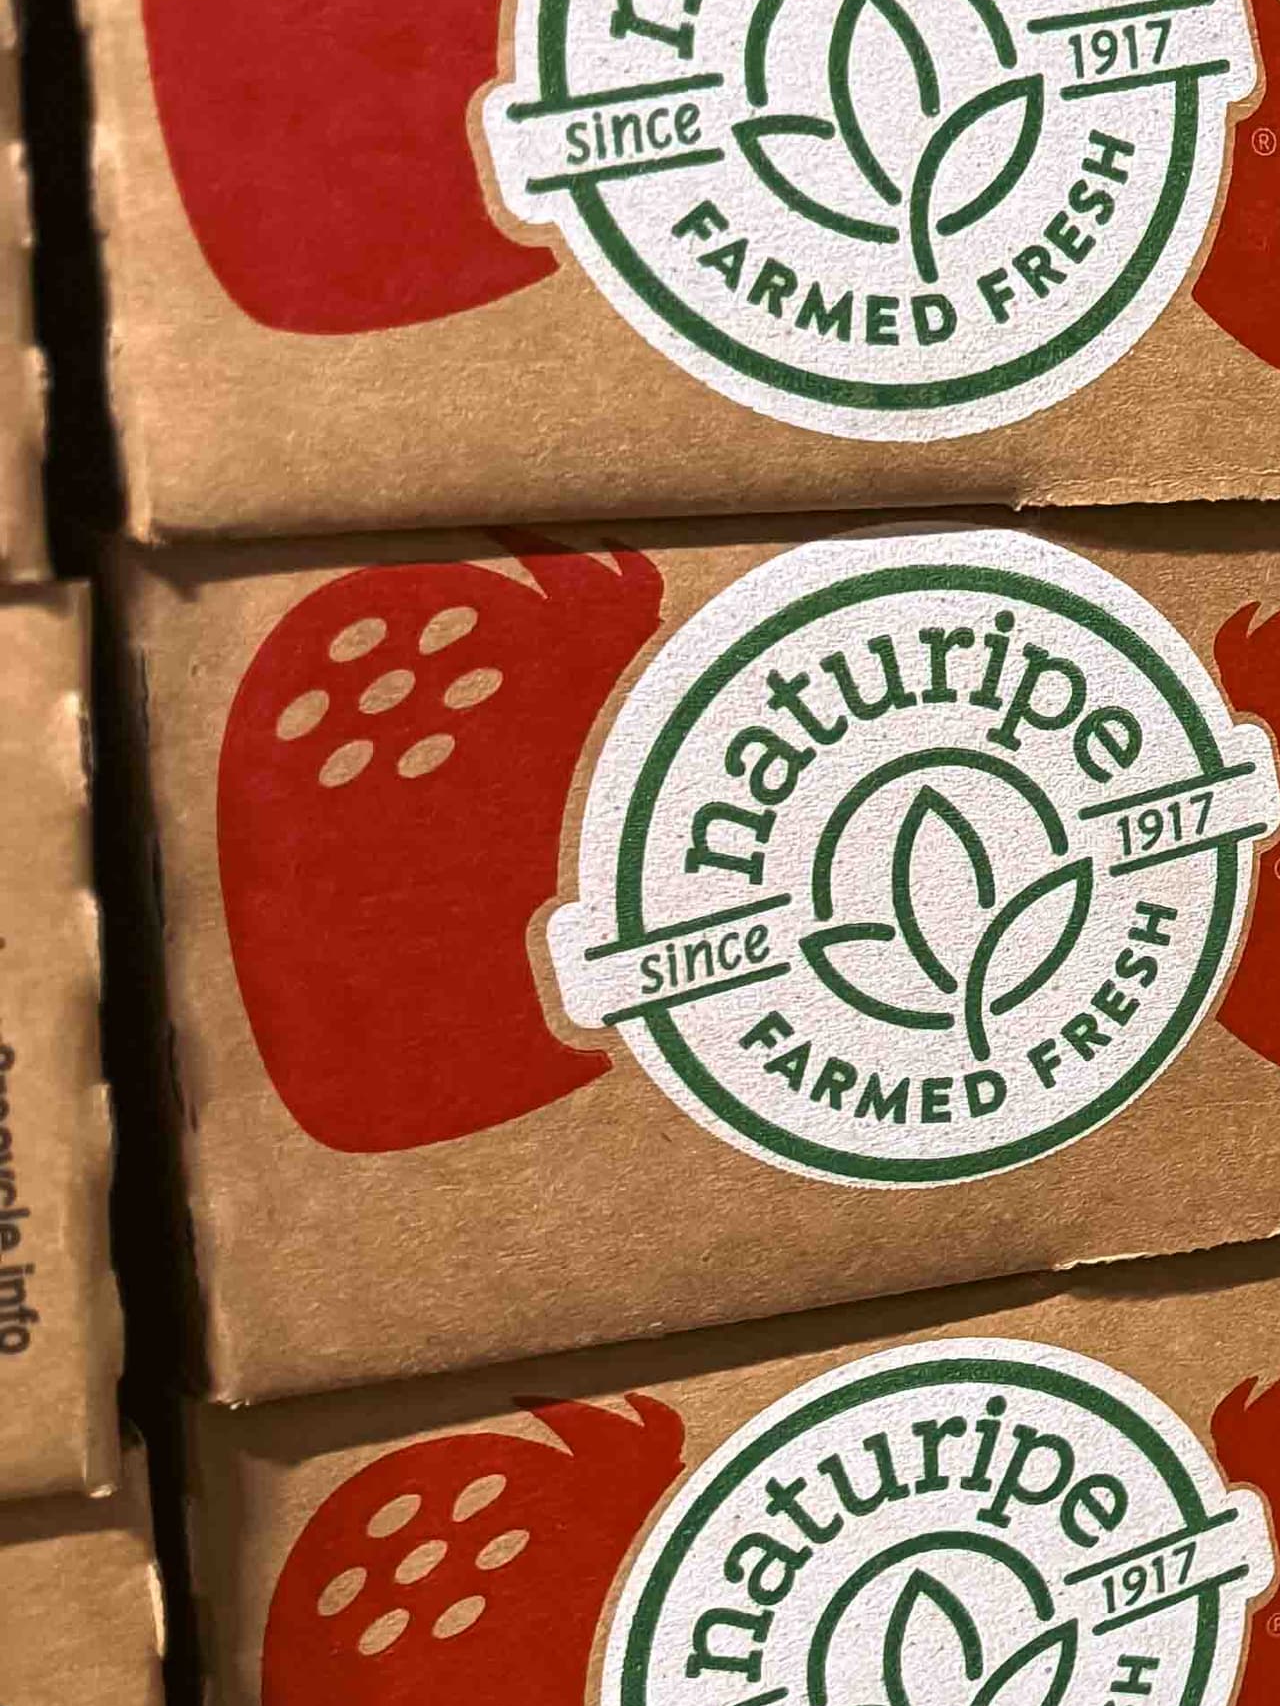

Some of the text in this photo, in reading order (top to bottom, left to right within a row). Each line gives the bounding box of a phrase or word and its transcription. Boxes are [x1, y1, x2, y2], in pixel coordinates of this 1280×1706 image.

[566, 20, 1173, 167] since 1917
[671, 127, 1136, 346] FARMED FRESH
[685, 610, 1143, 885] naturipe
[640, 792, 1215, 995] since 1917
[739, 900, 1178, 1124] FARMED FRESH
[685, 1395, 1129, 1683] naturipe
[1102, 1542, 1199, 1615] 1917
